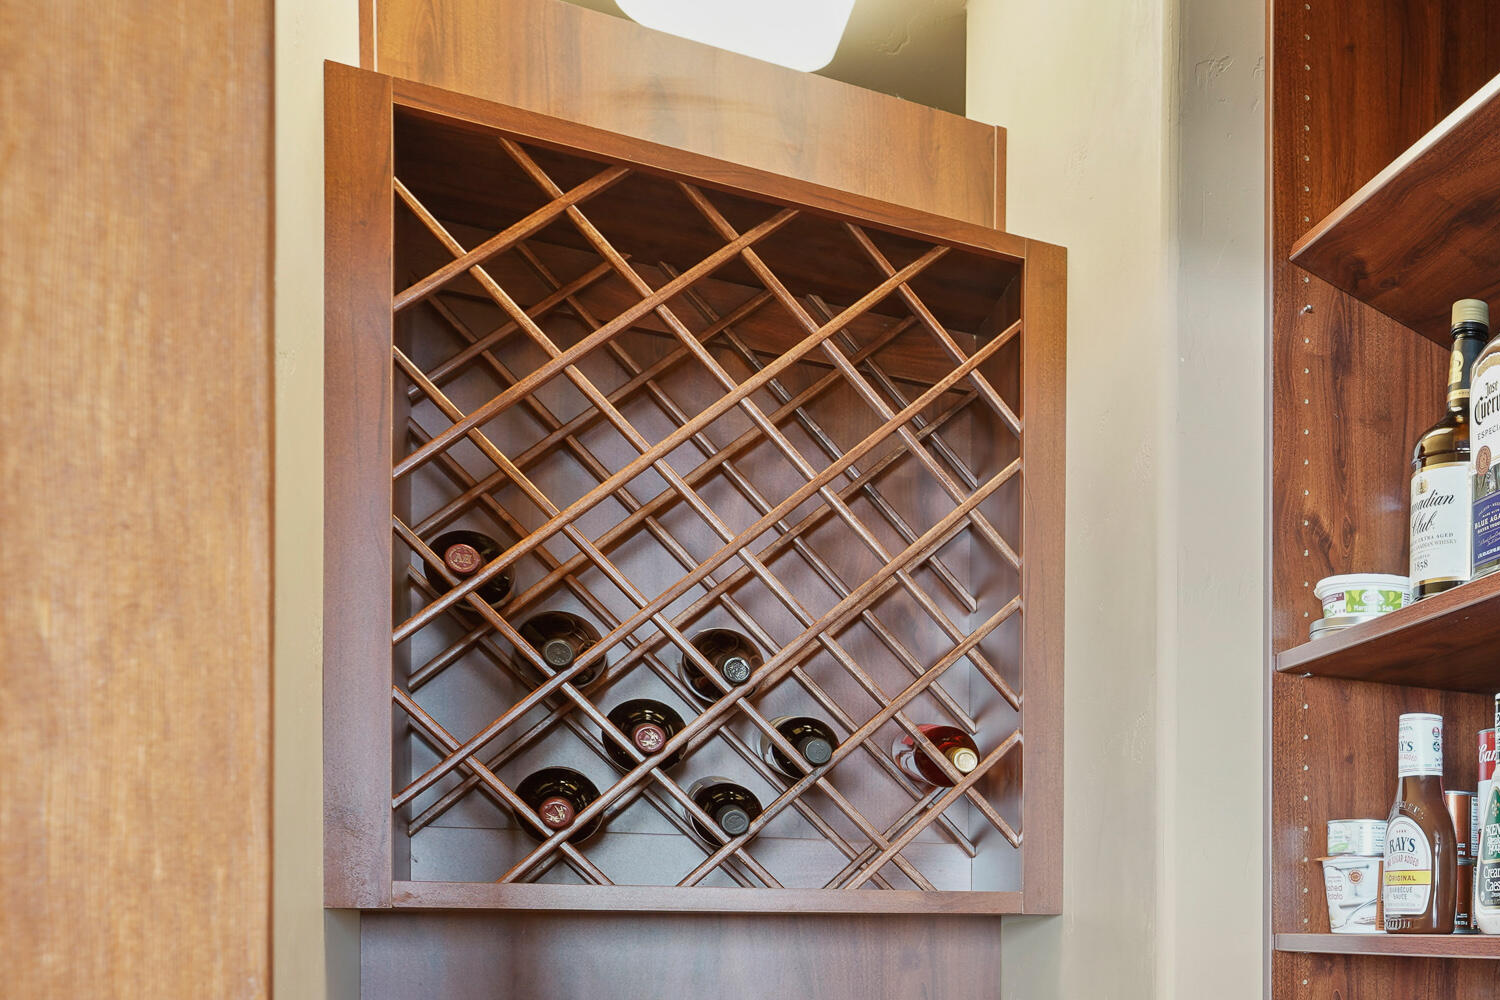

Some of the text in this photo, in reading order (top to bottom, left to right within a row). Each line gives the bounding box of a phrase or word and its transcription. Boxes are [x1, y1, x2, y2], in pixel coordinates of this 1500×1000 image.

[1474, 517, 1489, 530] BLUE
[1389, 836, 1417, 854] RAY'S
[1388, 874, 1417, 882] ORIGINAL
